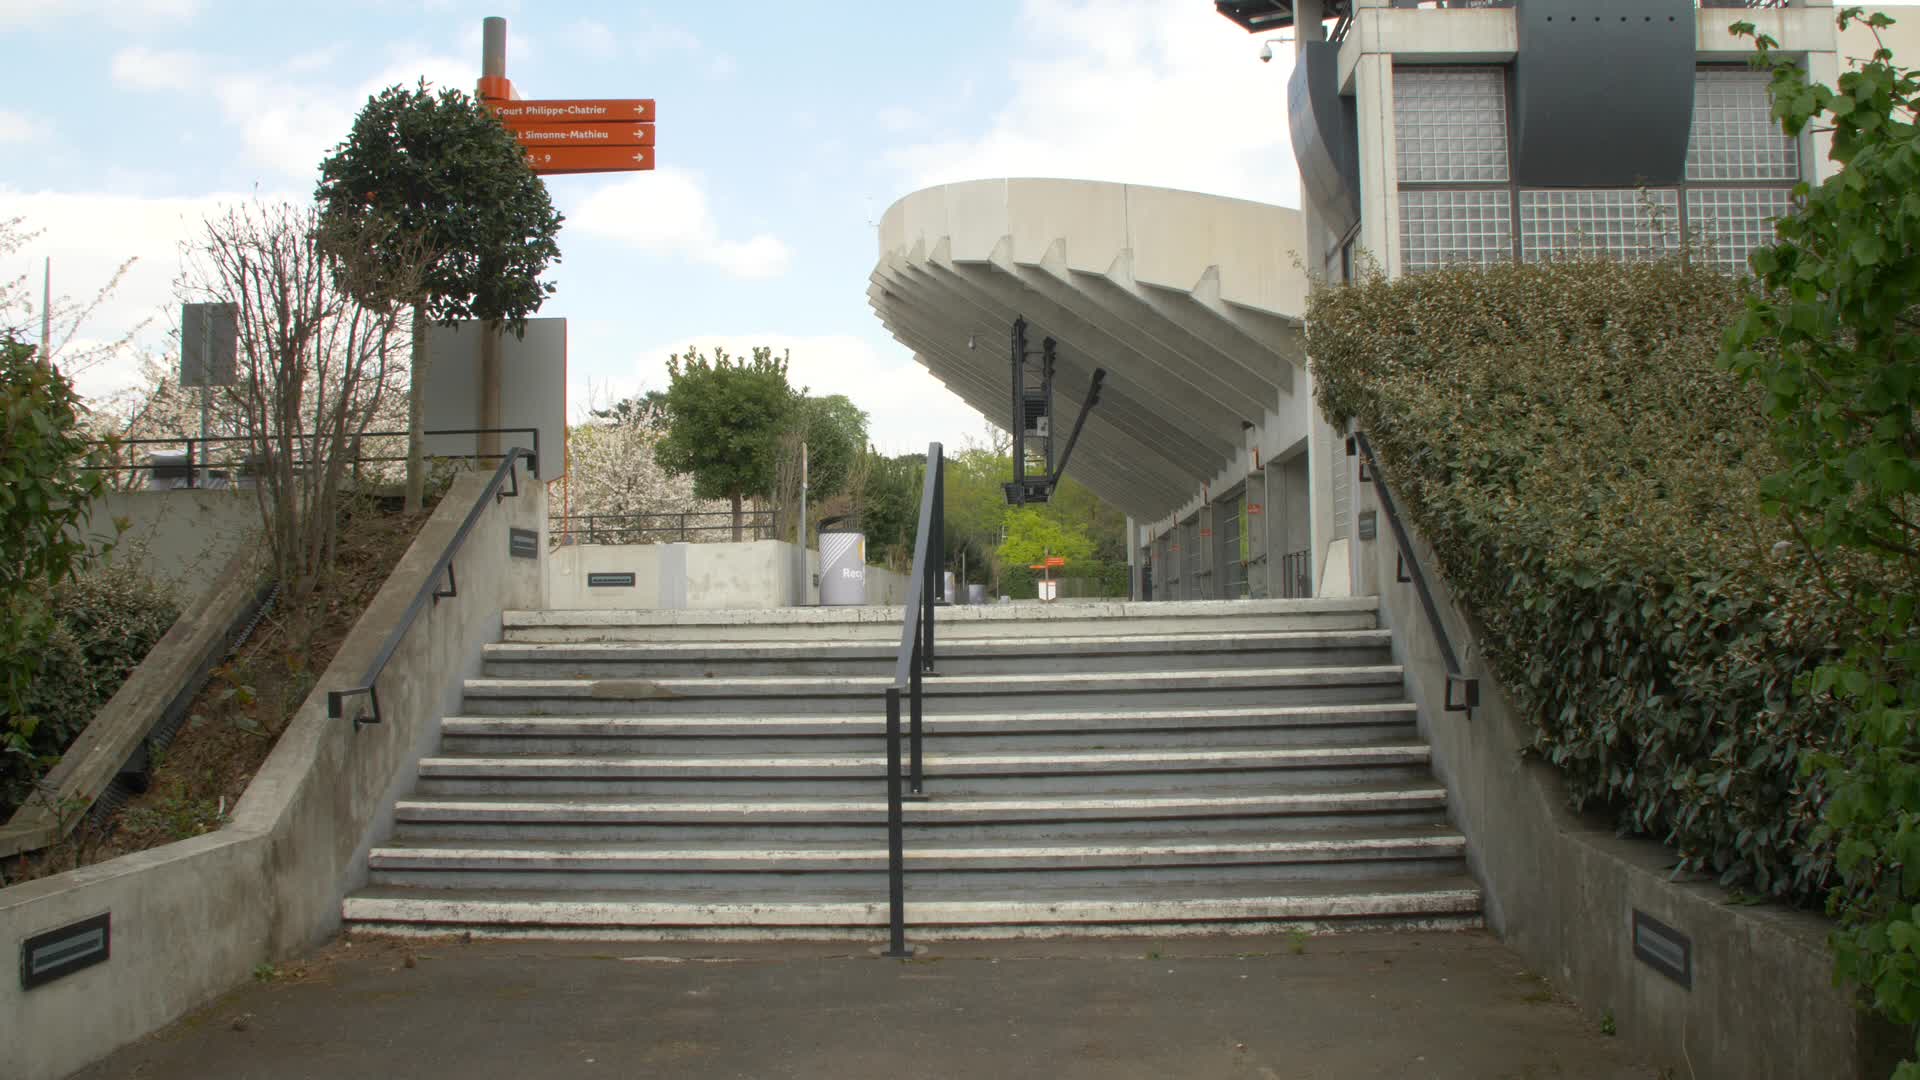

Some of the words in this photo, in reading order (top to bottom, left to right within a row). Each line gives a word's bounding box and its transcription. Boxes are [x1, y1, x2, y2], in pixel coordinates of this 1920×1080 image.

[496, 107, 522, 116] Court
[526, 105, 607, 116] Philippe-Chatrier
[526, 130, 609, 139] Simonne-Mathieu
[544, 154, 551, 162] 9
